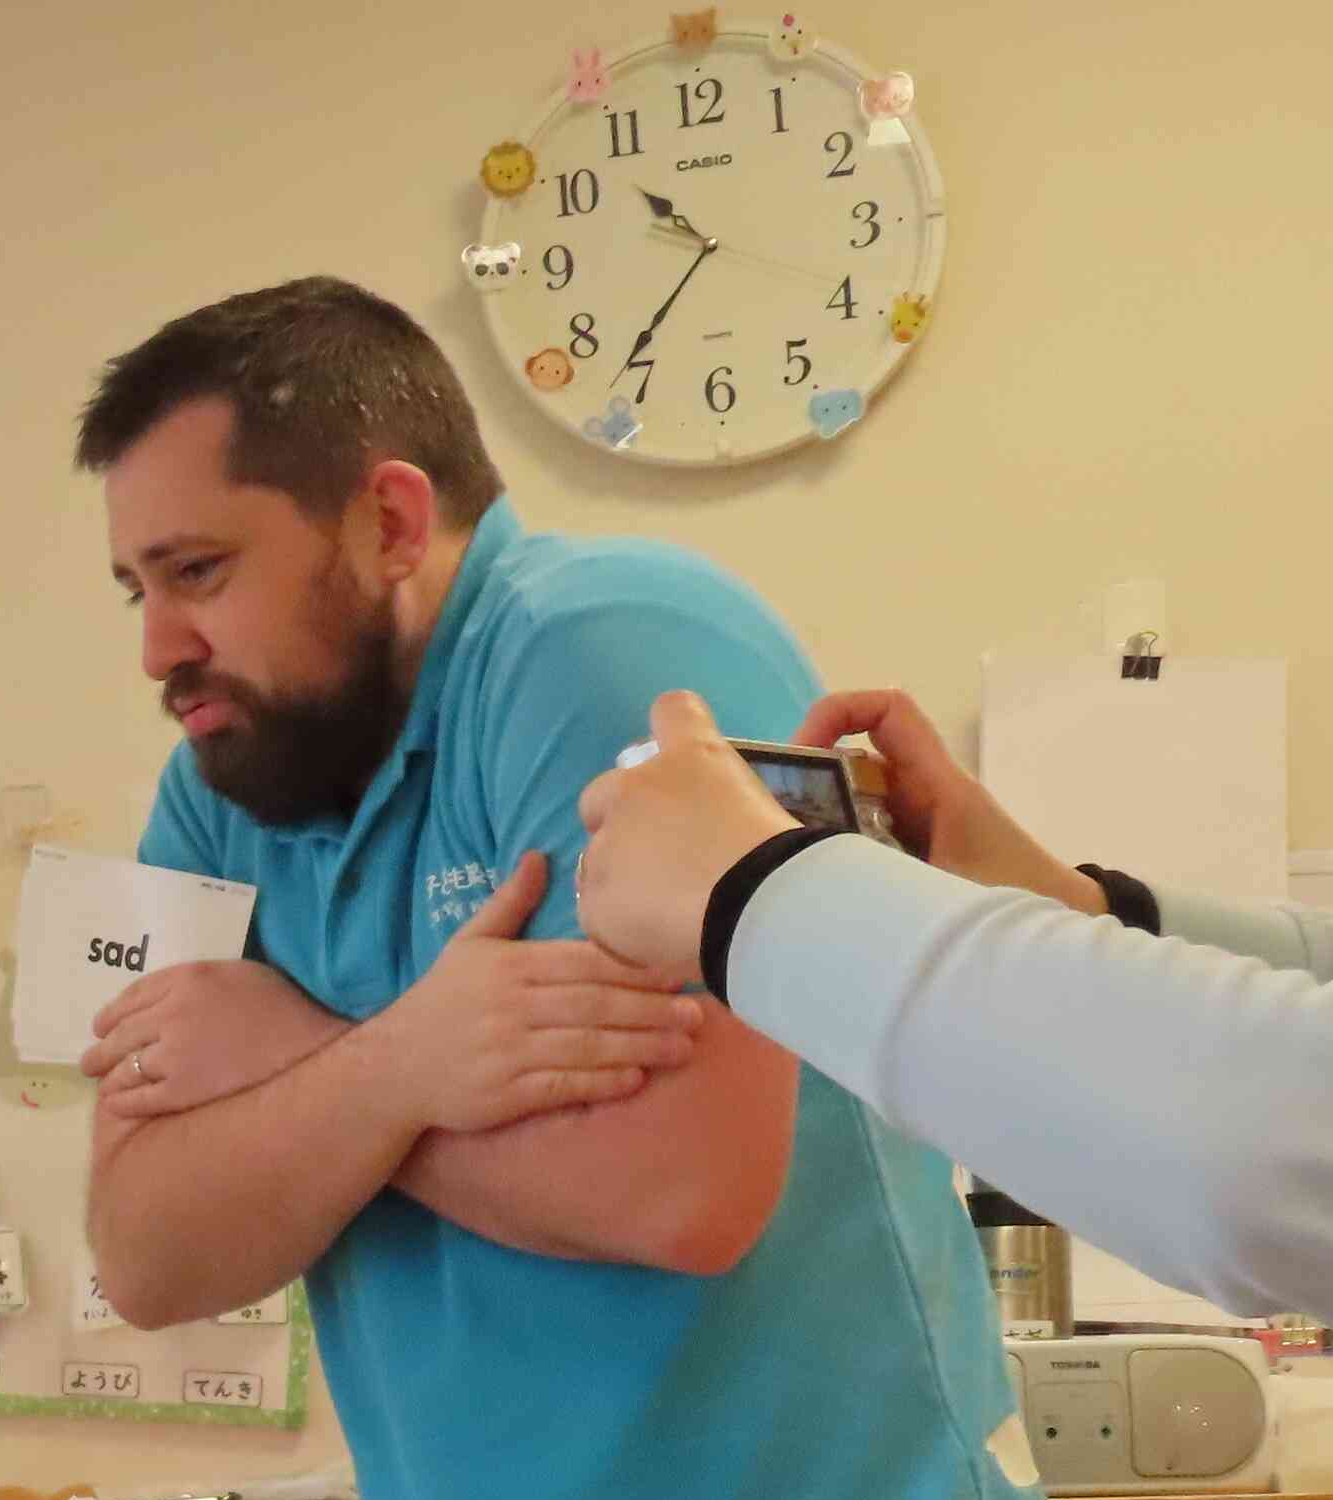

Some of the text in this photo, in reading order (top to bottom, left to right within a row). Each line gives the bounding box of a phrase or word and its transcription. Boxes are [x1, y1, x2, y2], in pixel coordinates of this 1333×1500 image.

[675, 78, 726, 129] 12
[768, 87, 790, 134] 1
[605, 109, 645, 159] 11
[823, 131, 857, 179] 2
[676, 154, 732, 171] CASIO
[556, 168, 600, 218] 10
[850, 200, 882, 249] 3
[542, 244, 575, 290] 9
[825, 274, 859, 321] 4
[569, 313, 600, 359] 8
[626, 356, 656, 404] 7
[783, 338, 812, 386] 5
[704, 365, 737, 414] 6
[87, 933, 150, 973] sad
[70, 1370, 133, 1391] ようび
[193, 1379, 253, 1400] てんき
